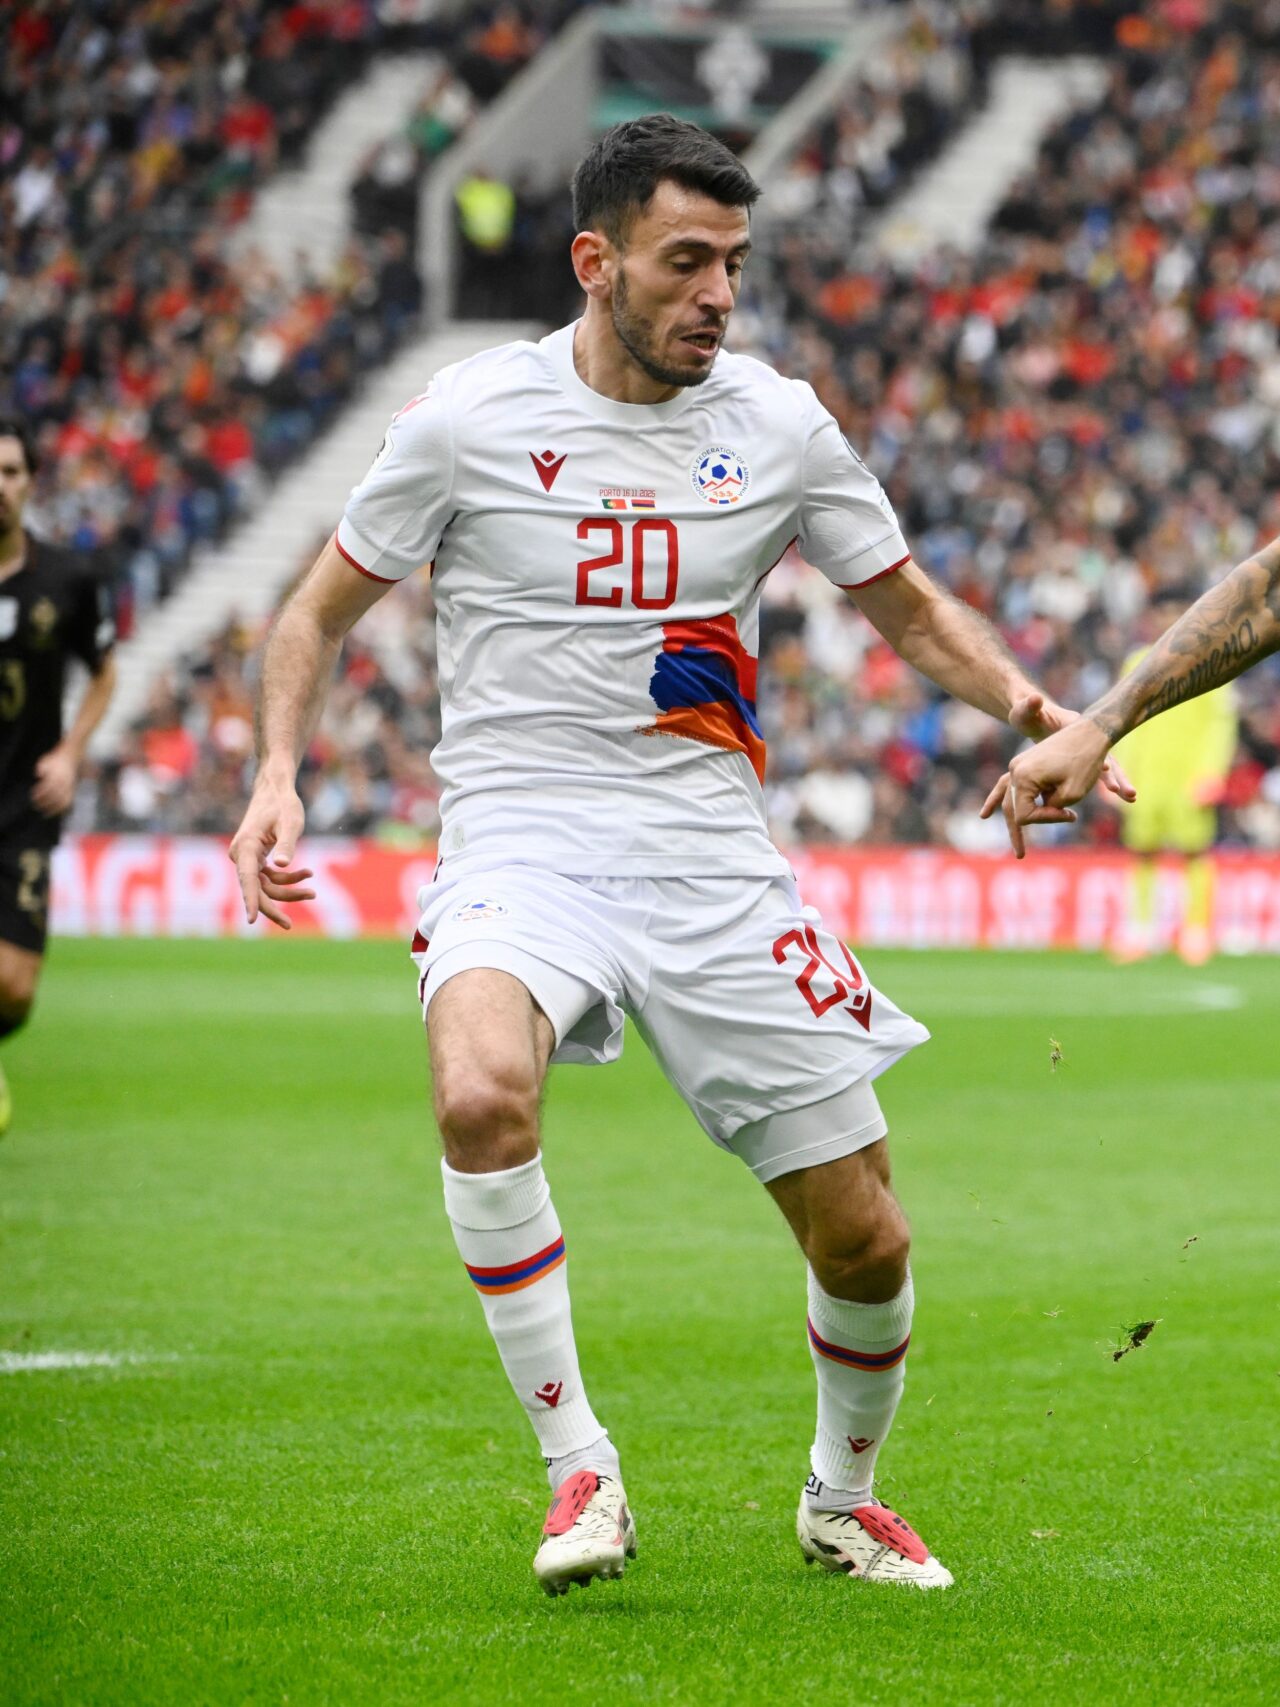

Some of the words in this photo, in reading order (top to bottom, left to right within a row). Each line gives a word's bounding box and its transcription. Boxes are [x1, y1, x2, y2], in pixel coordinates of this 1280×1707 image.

[599, 488, 621, 497] PORTO
[695, 447, 737, 464] FEDERATION
[575, 517, 679, 611] 20
[48, 834, 364, 942] AGRS
[771, 922, 863, 1019] 20
